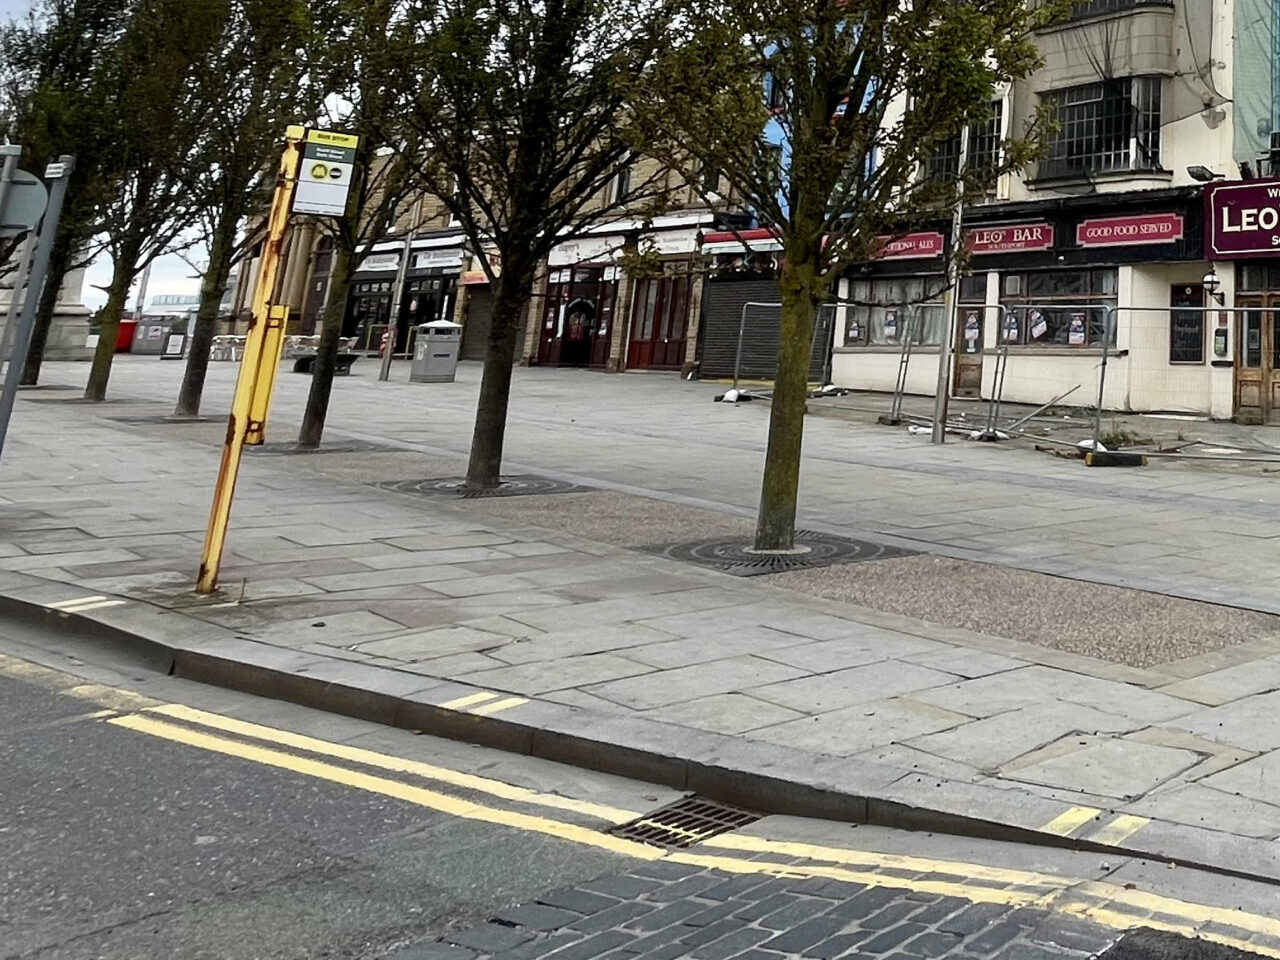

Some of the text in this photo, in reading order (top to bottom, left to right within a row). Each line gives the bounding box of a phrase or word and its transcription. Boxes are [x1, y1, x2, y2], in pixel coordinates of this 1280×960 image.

[1013, 227, 1043, 242] BAR
[1086, 222, 1172, 238] GOOD FOOD SERVED
[919, 239, 934, 249] ALES
